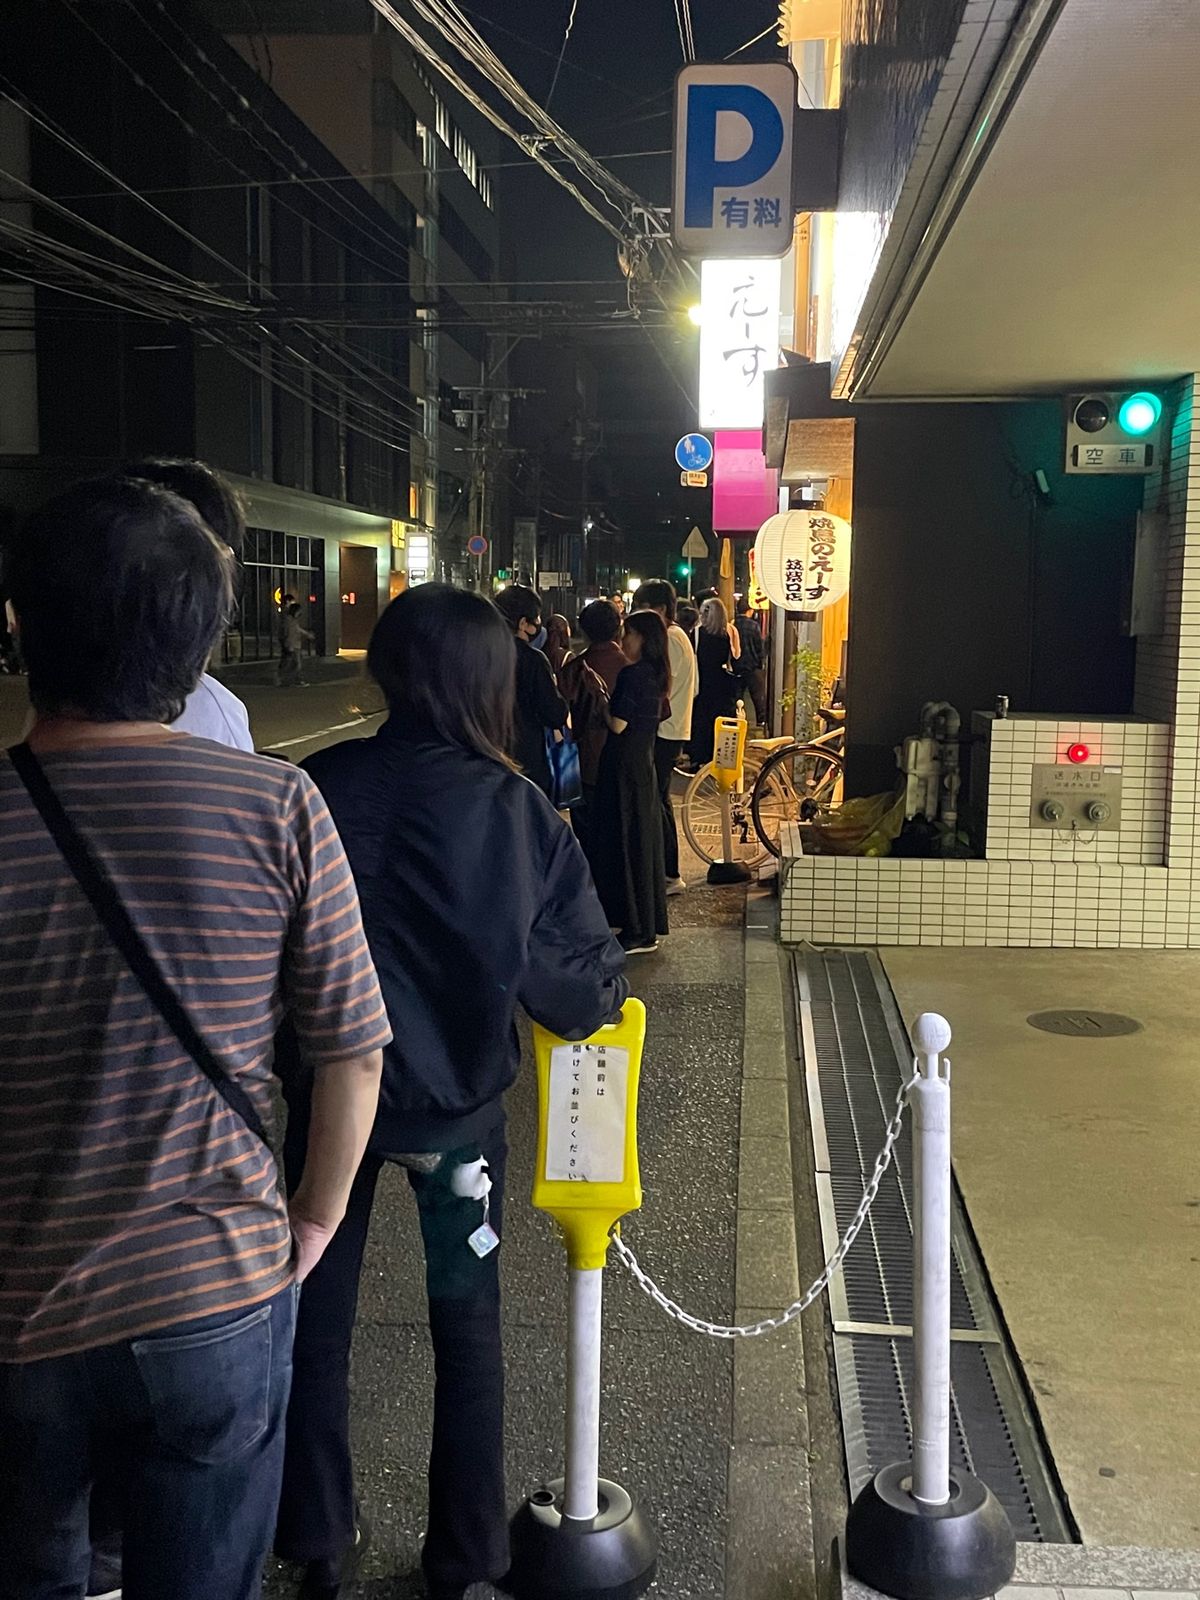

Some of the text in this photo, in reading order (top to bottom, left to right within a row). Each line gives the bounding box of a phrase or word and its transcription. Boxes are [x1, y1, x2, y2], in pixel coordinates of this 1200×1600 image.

[684, 84, 784, 228] P
[720, 197, 782, 229] 有料
[722, 275, 769, 387] えーす
[1085, 448, 1136, 465] 空車
[786, 558, 803, 601] 筑紫口店
[805, 517, 836, 600] 焼鳥のえーす
